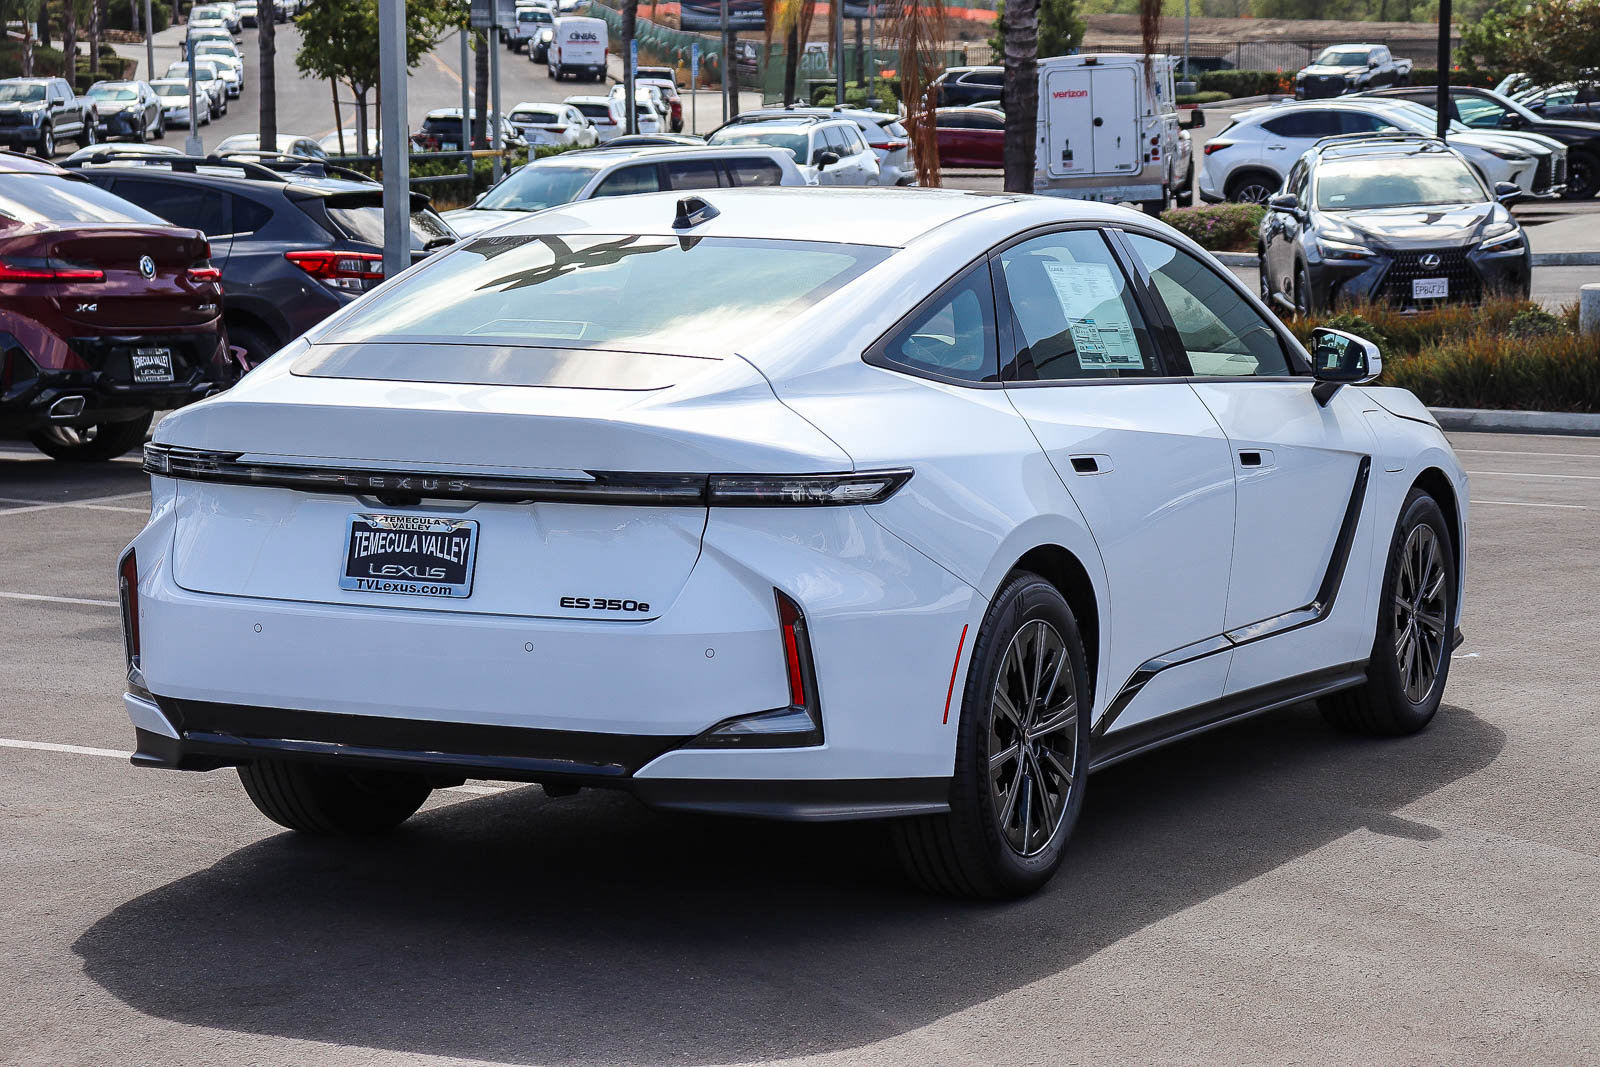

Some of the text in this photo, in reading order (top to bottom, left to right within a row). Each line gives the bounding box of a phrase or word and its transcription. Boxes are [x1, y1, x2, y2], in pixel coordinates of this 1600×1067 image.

[1053, 89, 1088, 99] verizon
[344, 475, 464, 492] LEXUS
[383, 515, 441, 526] TEMECULA
[391, 522, 431, 531] VALLEY
[354, 531, 469, 566] TEMECULA VALLEY
[368, 562, 447, 579] LEXUS
[356, 578, 452, 595] TVLexus.com
[560, 596, 650, 612] ES 350e
